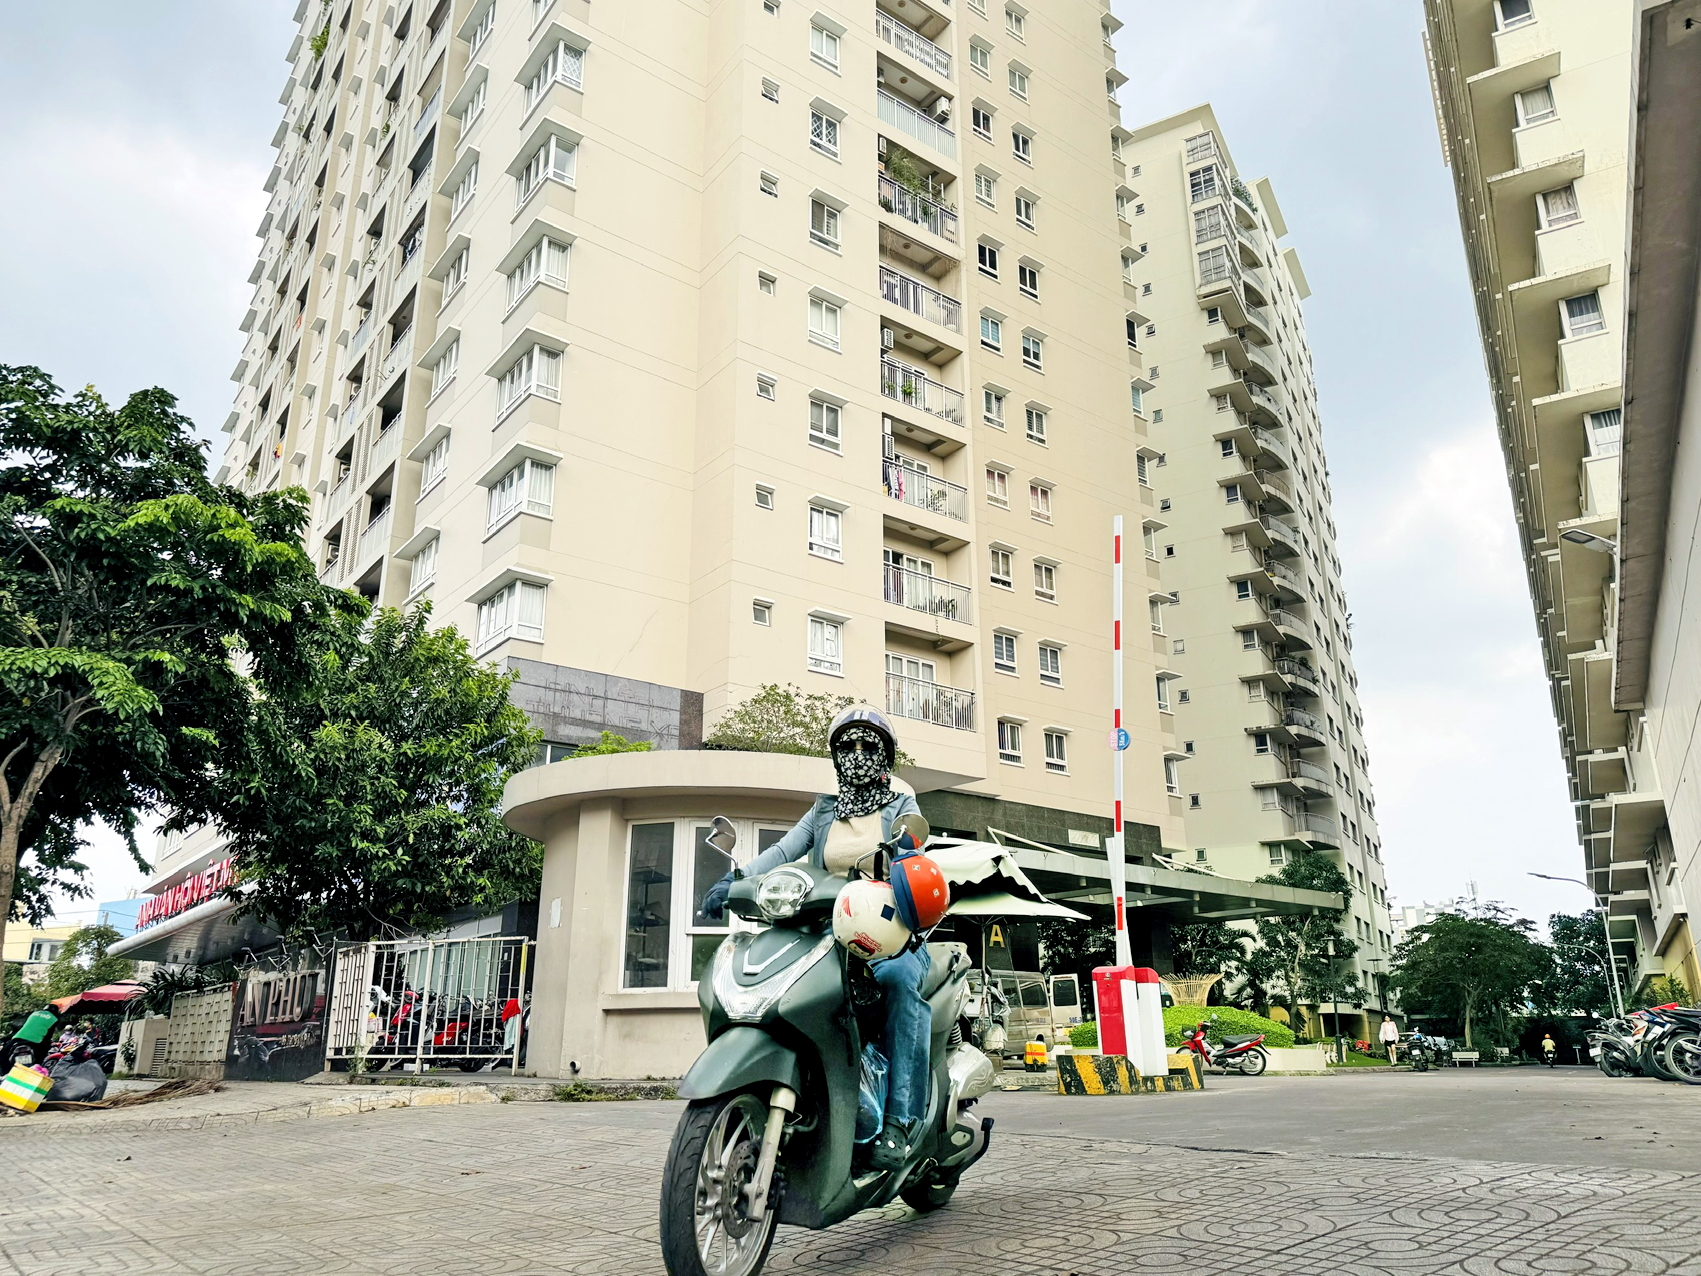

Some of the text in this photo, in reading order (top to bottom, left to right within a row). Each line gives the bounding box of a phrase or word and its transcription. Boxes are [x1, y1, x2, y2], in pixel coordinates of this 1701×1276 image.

[173, 872, 195, 912] HỘI
[193, 858, 222, 902] VIỆT
[989, 924, 1005, 948] A
